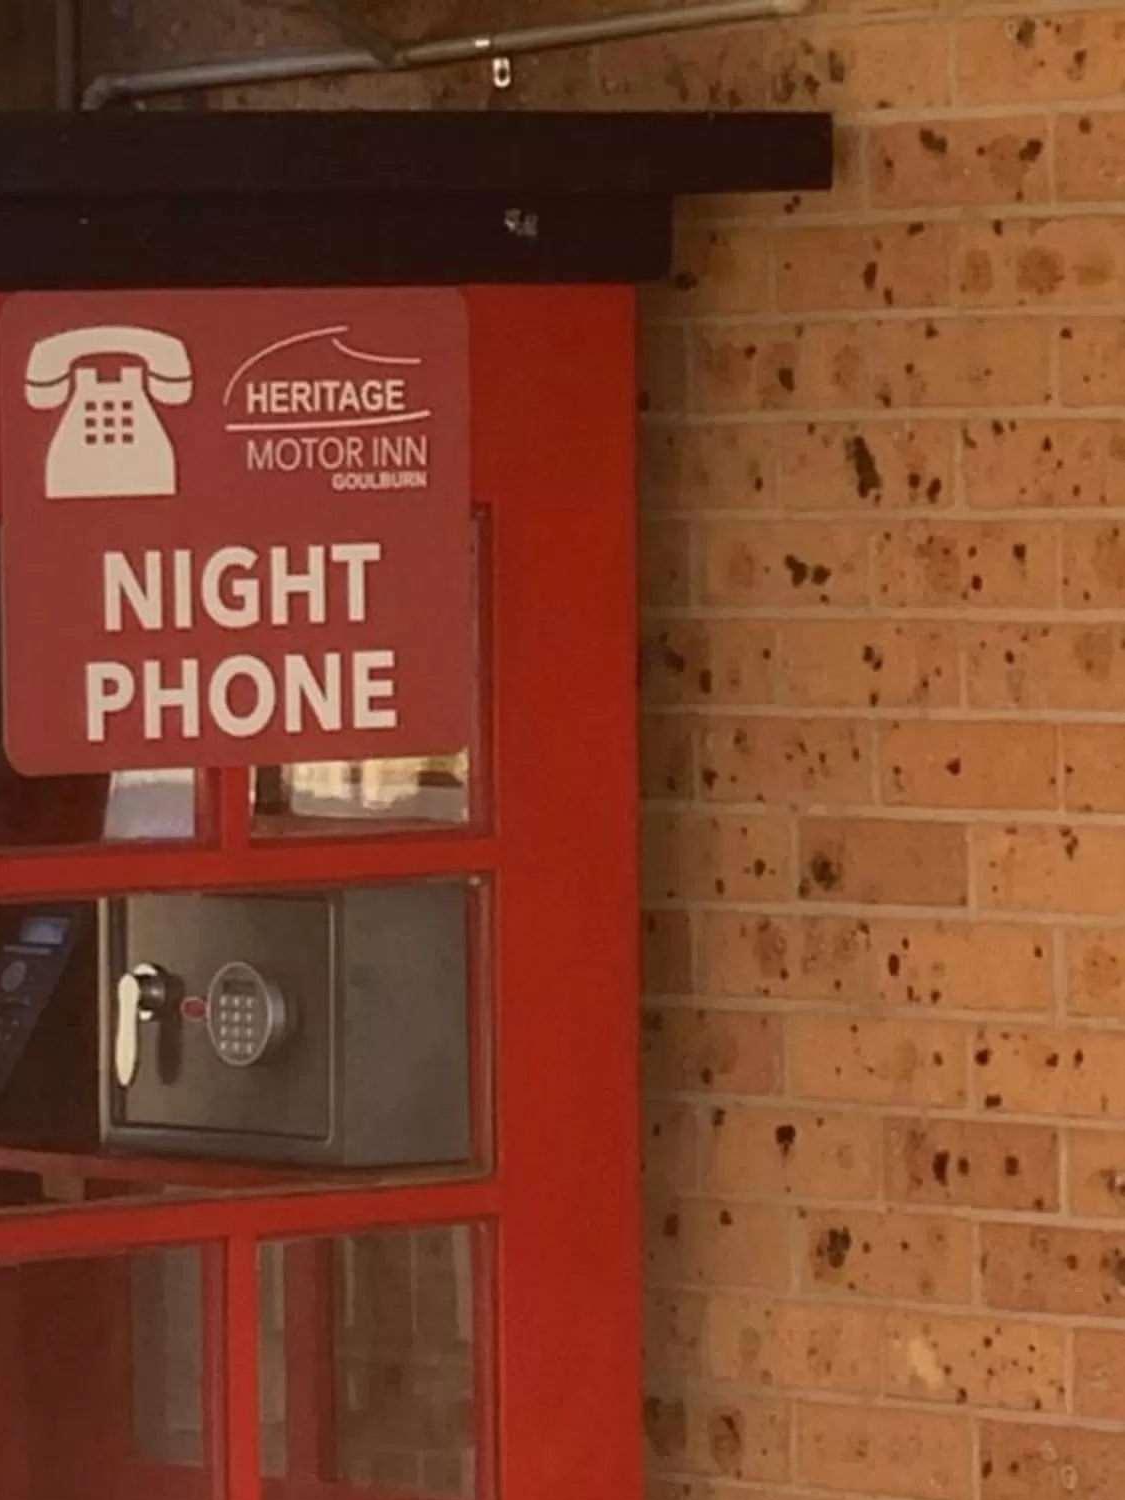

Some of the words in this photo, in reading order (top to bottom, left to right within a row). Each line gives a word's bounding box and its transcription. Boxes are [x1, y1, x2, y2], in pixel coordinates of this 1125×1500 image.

[246, 380, 406, 413] HERITAGE
[246, 437, 363, 470] MOTOR
[374, 437, 428, 467] INN
[332, 472, 428, 491] GOULBURN
[103, 544, 381, 631] NIGHT
[86, 651, 397, 742] PHONE
